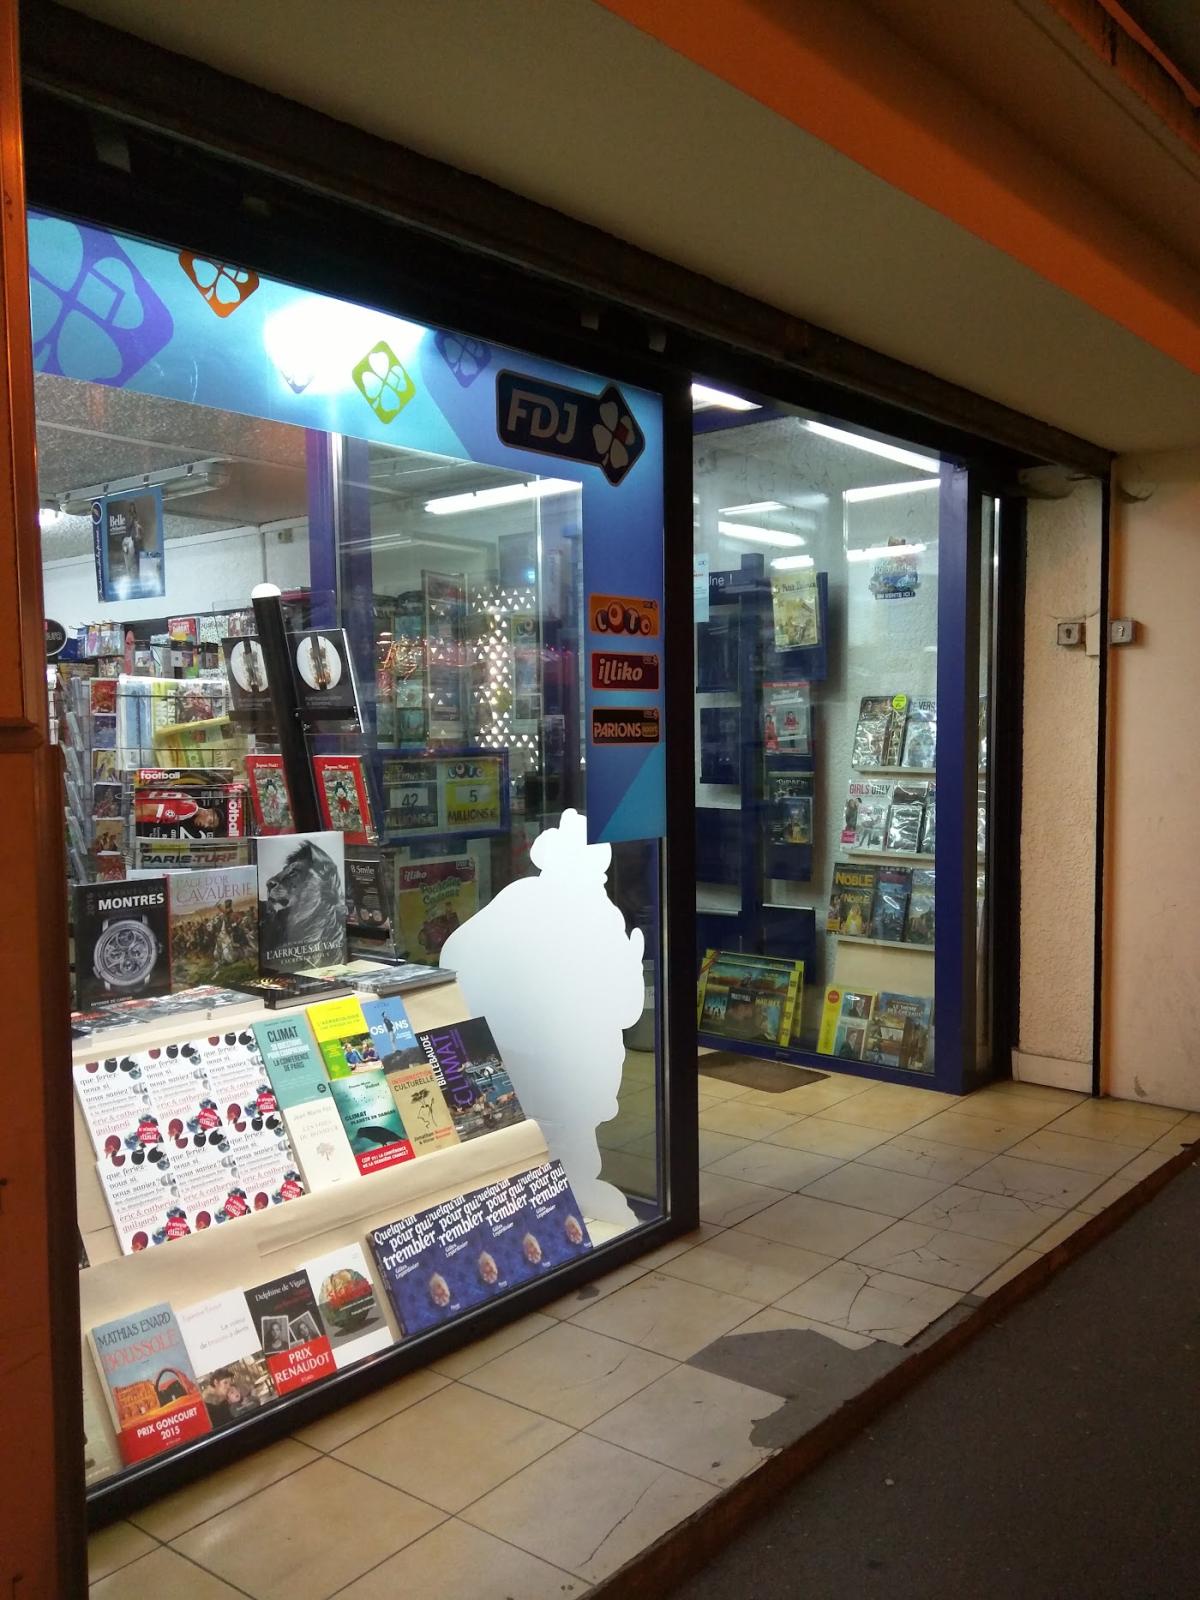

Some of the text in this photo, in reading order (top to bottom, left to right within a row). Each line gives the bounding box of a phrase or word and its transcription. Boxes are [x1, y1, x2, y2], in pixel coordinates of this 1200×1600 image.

[506, 388, 578, 444] FDJ
[109, 513, 126, 527] Belle
[596, 601, 651, 635] LOTO
[599, 658, 643, 684] illiko
[593, 722, 642, 738] PARIONS
[140, 770, 180, 780] football
[401, 793, 418, 808] 42
[469, 789, 478, 803] 5
[849, 783, 870, 795] GIRLS
[140, 852, 239, 864] PARIS-TURF
[404, 871, 427, 881] illiko
[835, 872, 873, 887] NOBLE
[98, 893, 164, 911] MONTRES
[176, 882, 253, 903] CAVALERIE
[266, 944, 307, 960] L'AFRIQUE
[267, 1026, 298, 1042] CLIMAT
[420, 1034, 447, 1087] BILLEBAUDE
[430, 1034, 473, 1105] CLIMAT
[394, 1075, 435, 1092] CULTURELLE
[344, 1110, 367, 1122] CLIMAT
[520, 1162, 552, 1185] uelqu'un
[529, 1163, 565, 1195] pour qui
[478, 1179, 511, 1201] uelqu'un
[486, 1179, 526, 1213] pour qui
[529, 1177, 568, 1209] rembler
[429, 1195, 466, 1221] uelqu'un
[438, 1196, 482, 1231] pour qui
[485, 1194, 528, 1226] rembler
[374, 1216, 418, 1246] Quelqu'un
[389, 1215, 434, 1252] pour qui
[438, 1210, 483, 1247] rembler
[382, 1230, 436, 1271] trembler
[255, 1288, 281, 1302] Delphine
[289, 1278, 306, 1289] Vigan
[97, 1323, 139, 1347] MATHIAS
[141, 1311, 171, 1332] ENARD
[100, 1328, 180, 1375] BOUSSOLE
[288, 1346, 313, 1364] PRIX
[274, 1351, 330, 1384] RENAUDOT
[136, 1407, 198, 1439] PRIX GONCOURT
[160, 1426, 181, 1440] 2015
